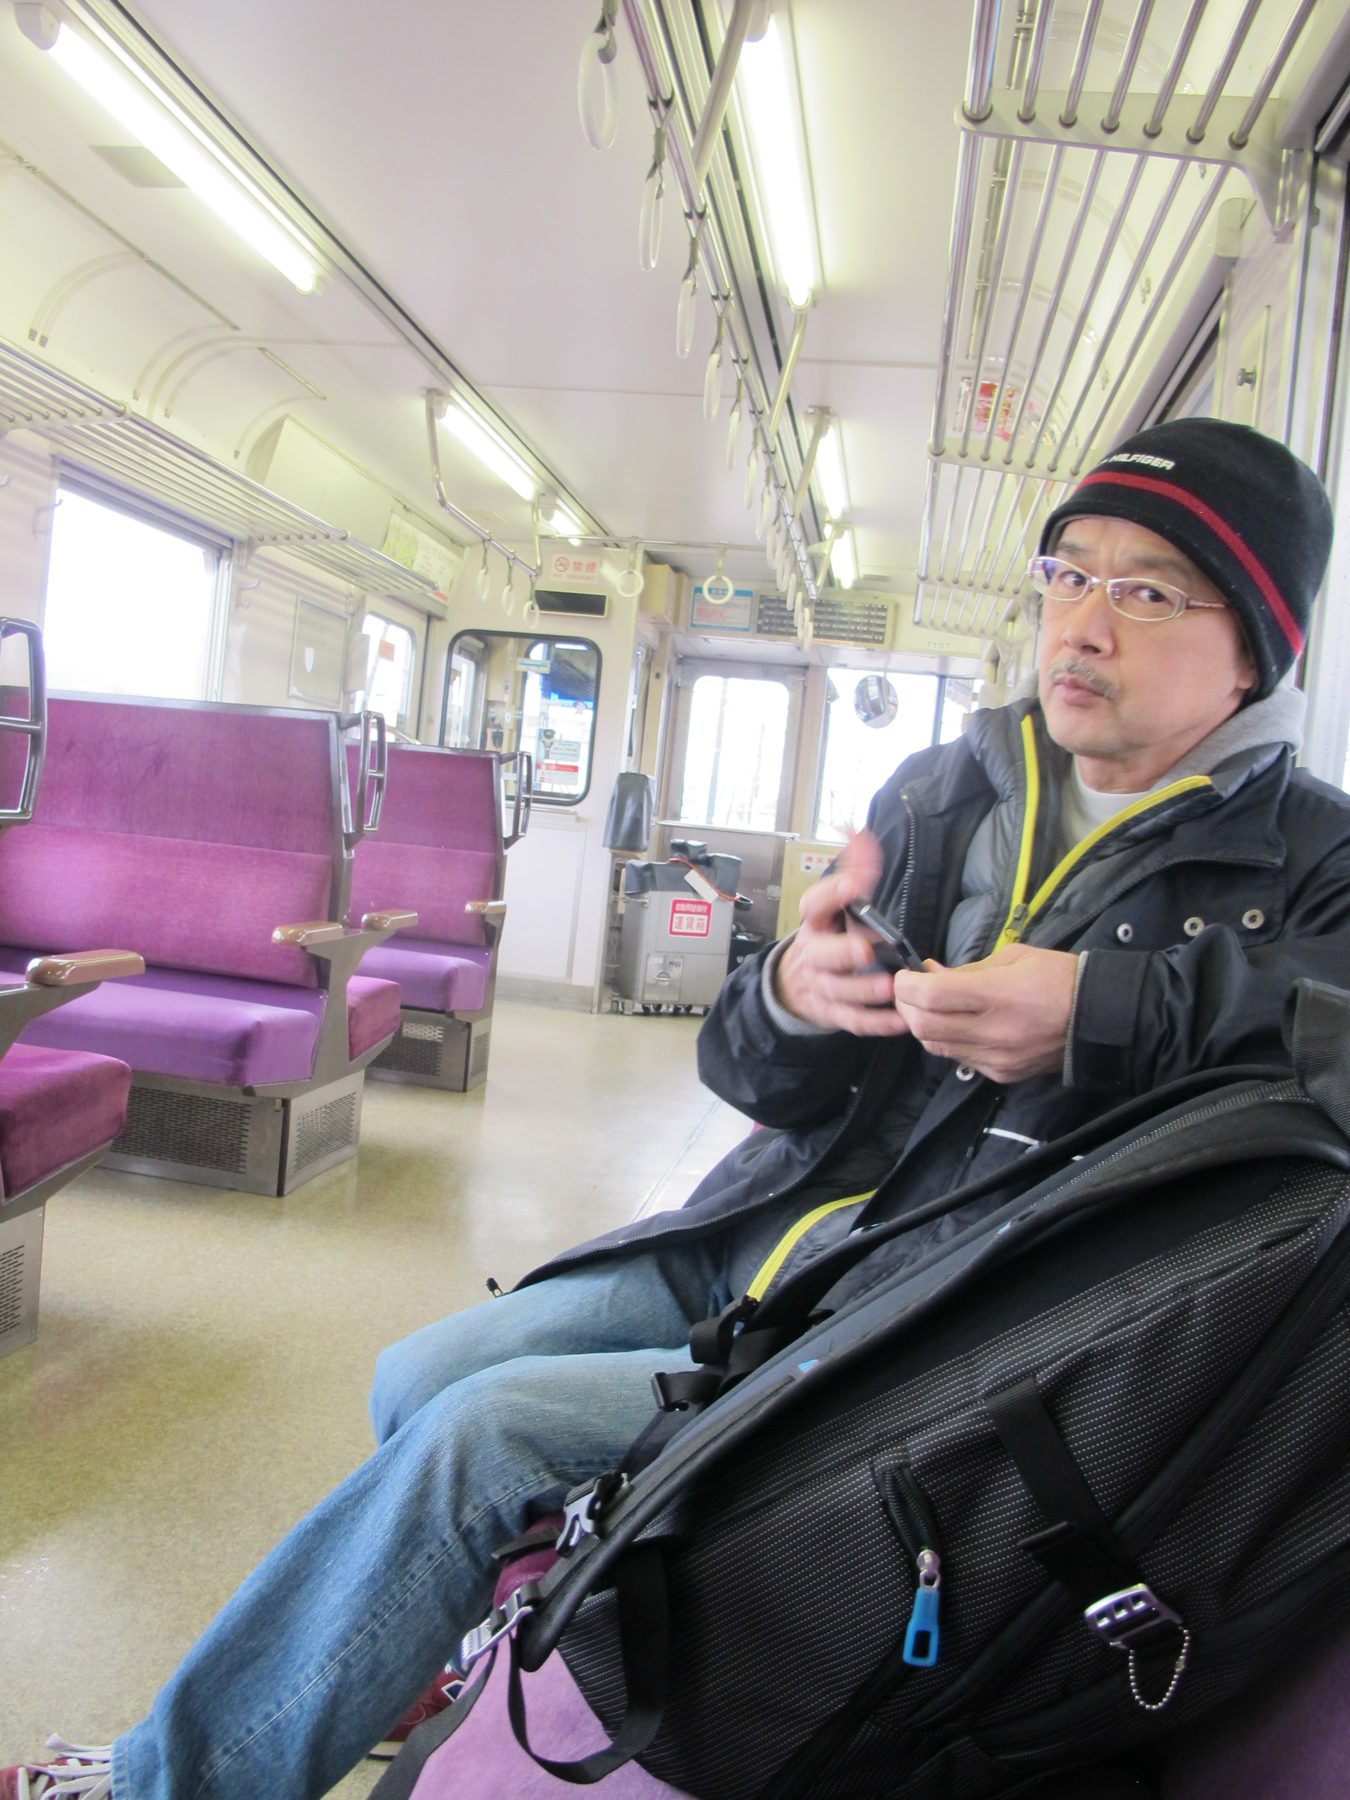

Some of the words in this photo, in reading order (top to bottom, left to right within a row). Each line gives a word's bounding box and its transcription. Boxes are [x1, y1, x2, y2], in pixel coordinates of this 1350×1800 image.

[1109, 453, 1176, 471] HILFIGER
[572, 560, 597, 573] 禁煙
[674, 915, 705, 932] 運賃箱
